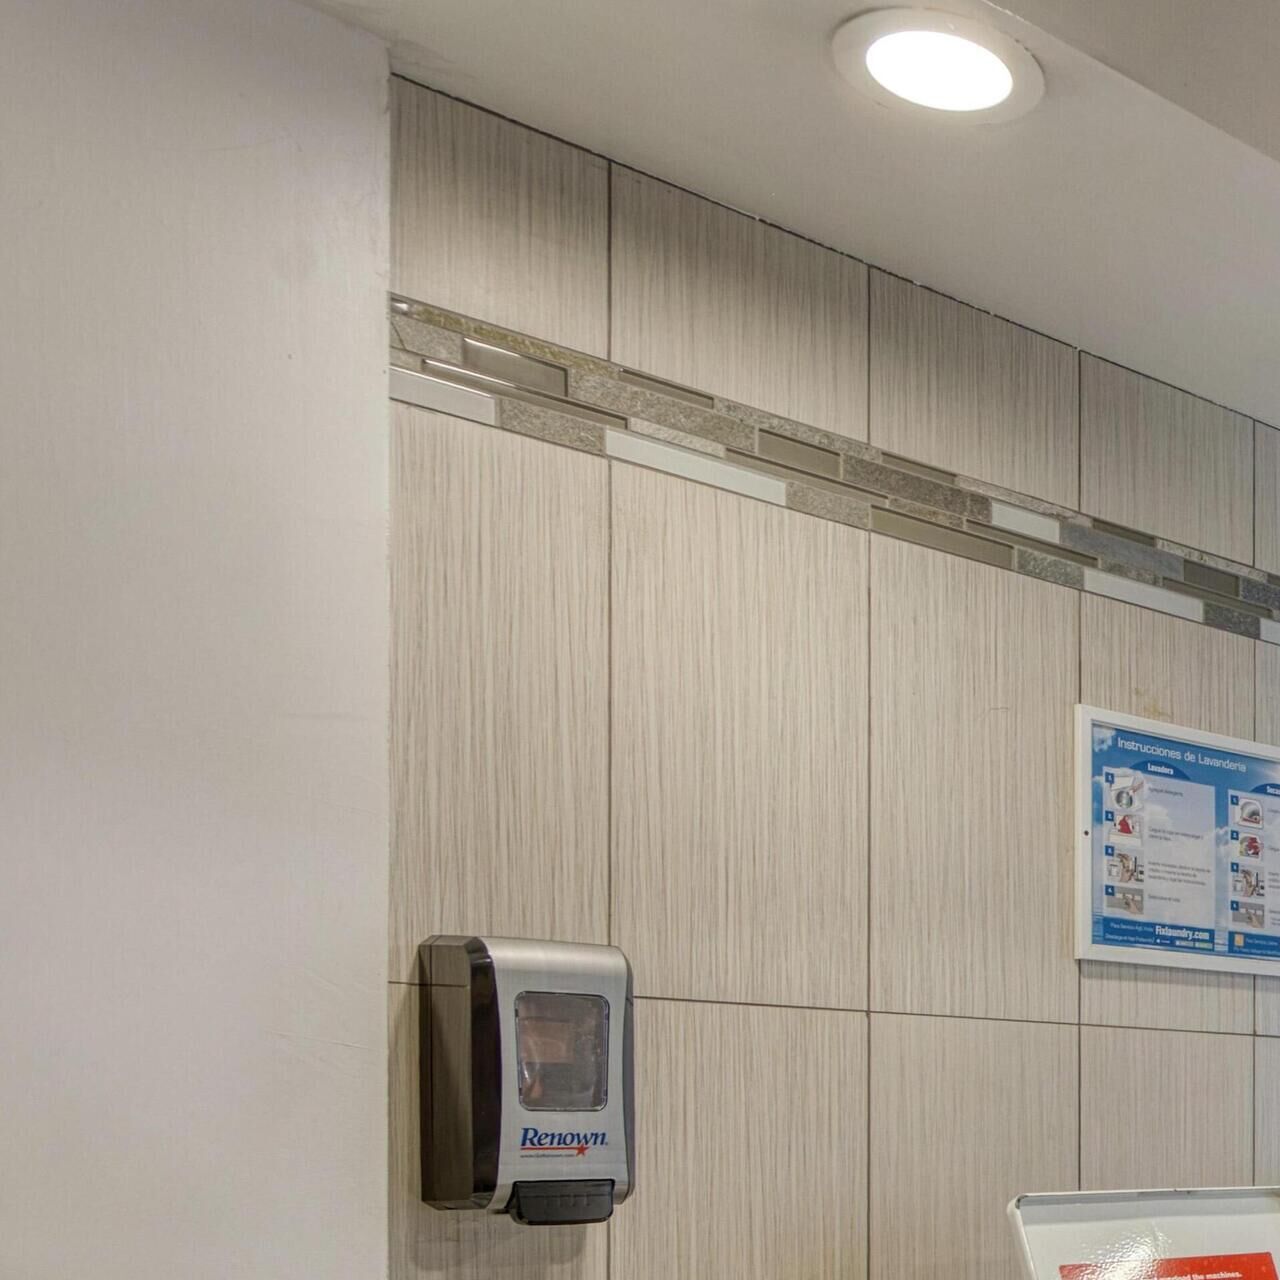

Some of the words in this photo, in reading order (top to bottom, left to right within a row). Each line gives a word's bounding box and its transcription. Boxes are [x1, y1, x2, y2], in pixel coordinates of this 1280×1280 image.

[1118, 737, 1181, 760] Instrucciones
[1184, 751, 1196, 762] de
[520, 1127, 607, 1147] Renown
[1191, 1273, 1205, 1280] the
